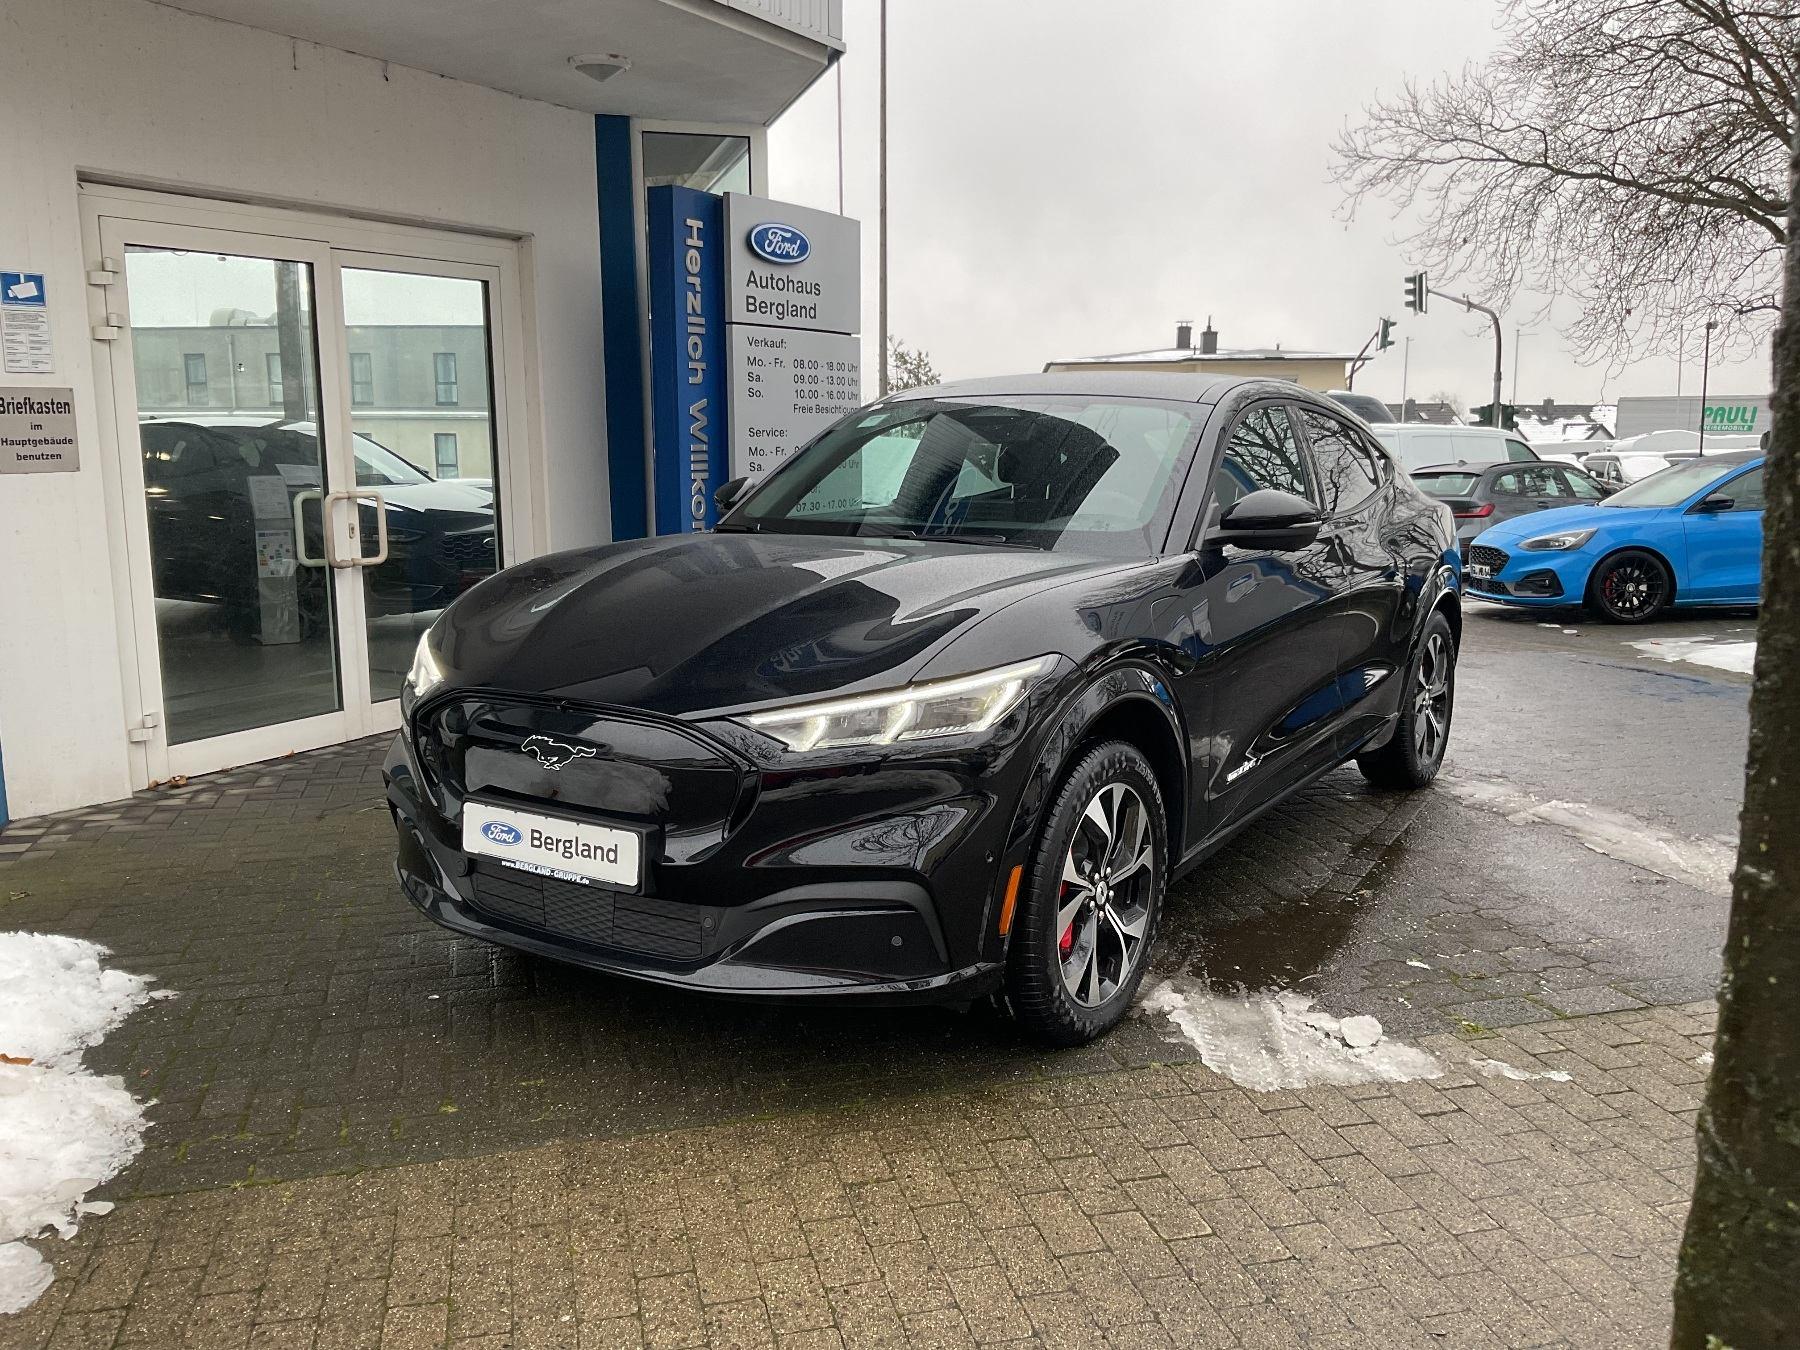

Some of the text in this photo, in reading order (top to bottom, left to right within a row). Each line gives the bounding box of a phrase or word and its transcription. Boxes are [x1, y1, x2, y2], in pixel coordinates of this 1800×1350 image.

[764, 227, 801, 257] Ford
[746, 270, 821, 296] Autohaus
[685, 218, 707, 385] Herzlich
[746, 295, 817, 320] Bergland
[747, 336, 787, 350] Verkauf:
[747, 356, 766, 368] Mo.
[774, 358, 786, 369] Fr.
[793, 359, 819, 370] 08.00
[847, 362, 858, 373] Uhr
[747, 372, 764, 383] Sa.
[793, 374, 819, 385] 09.00
[826, 376, 846, 387] 13.00
[847, 377, 858, 388] Uhr
[747, 388, 764, 399] So.
[795, 389, 819, 400] 10.00
[826, 390, 846, 401] 16.00
[847, 391, 858, 401] Uhr
[0, 397, 71, 415] Briefkasten
[793, 403, 858, 417] Freie Besichtigun
[1704, 406, 1758, 424] PAULI
[30, 422, 43, 431] im
[748, 427, 788, 438] Service:
[1, 437, 74, 448] Hauptgebäude
[16, 452, 62, 461] benutzen
[749, 446, 768, 456] Mo.
[775, 446, 787, 456] Fr.
[749, 462, 765, 472] Sa.
[796, 501, 820, 512] 07.30
[828, 499, 847, 510] 17.00
[488, 824, 618, 865] Ford Bergland
